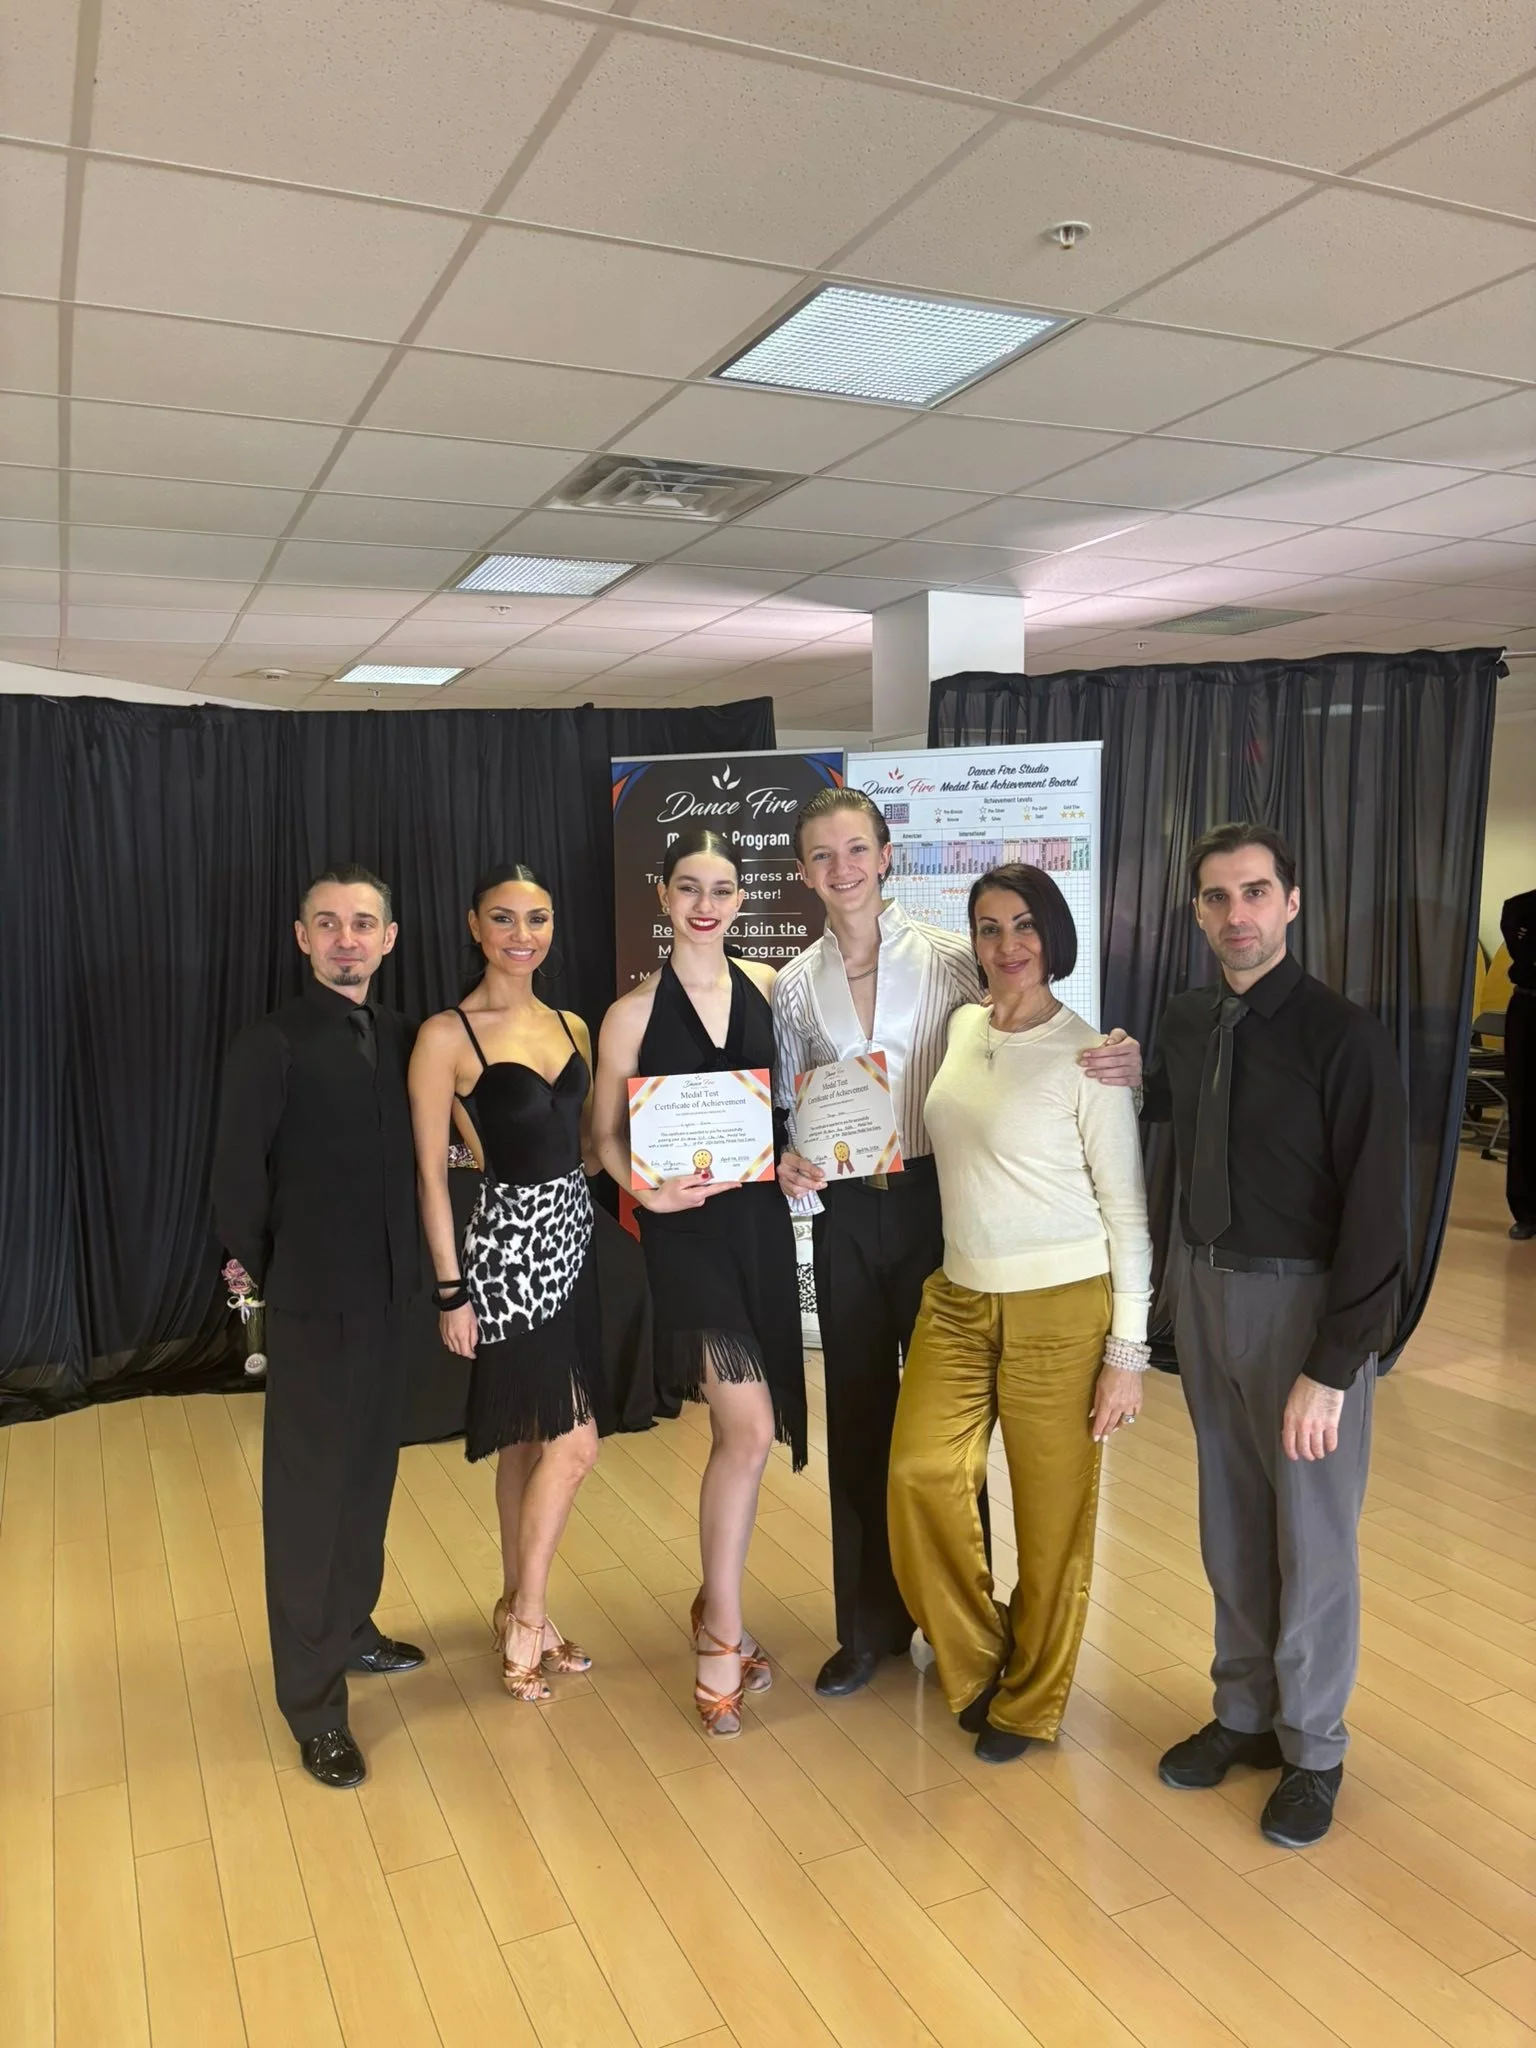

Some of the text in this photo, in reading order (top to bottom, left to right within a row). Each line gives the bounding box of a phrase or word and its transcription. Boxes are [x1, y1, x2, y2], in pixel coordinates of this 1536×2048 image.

[968, 763, 1049, 776] Dance Fire Studio
[863, 778, 936, 796] Dance Fire
[940, 776, 1079, 792] Medal Test Achievement Board
[656, 787, 799, 823] Dance Fire
[732, 830, 790, 851] Program
[741, 872, 804, 884] gress an
[743, 888, 781, 900] aster!
[743, 922, 775, 937] join
[779, 922, 807, 935] the
[732, 944, 801, 958] rogram
[681, 1090, 703, 1099] Medal
[836, 1084, 869, 1097] Achievement
[654, 1098, 746, 1111] Certificate of Achievement
